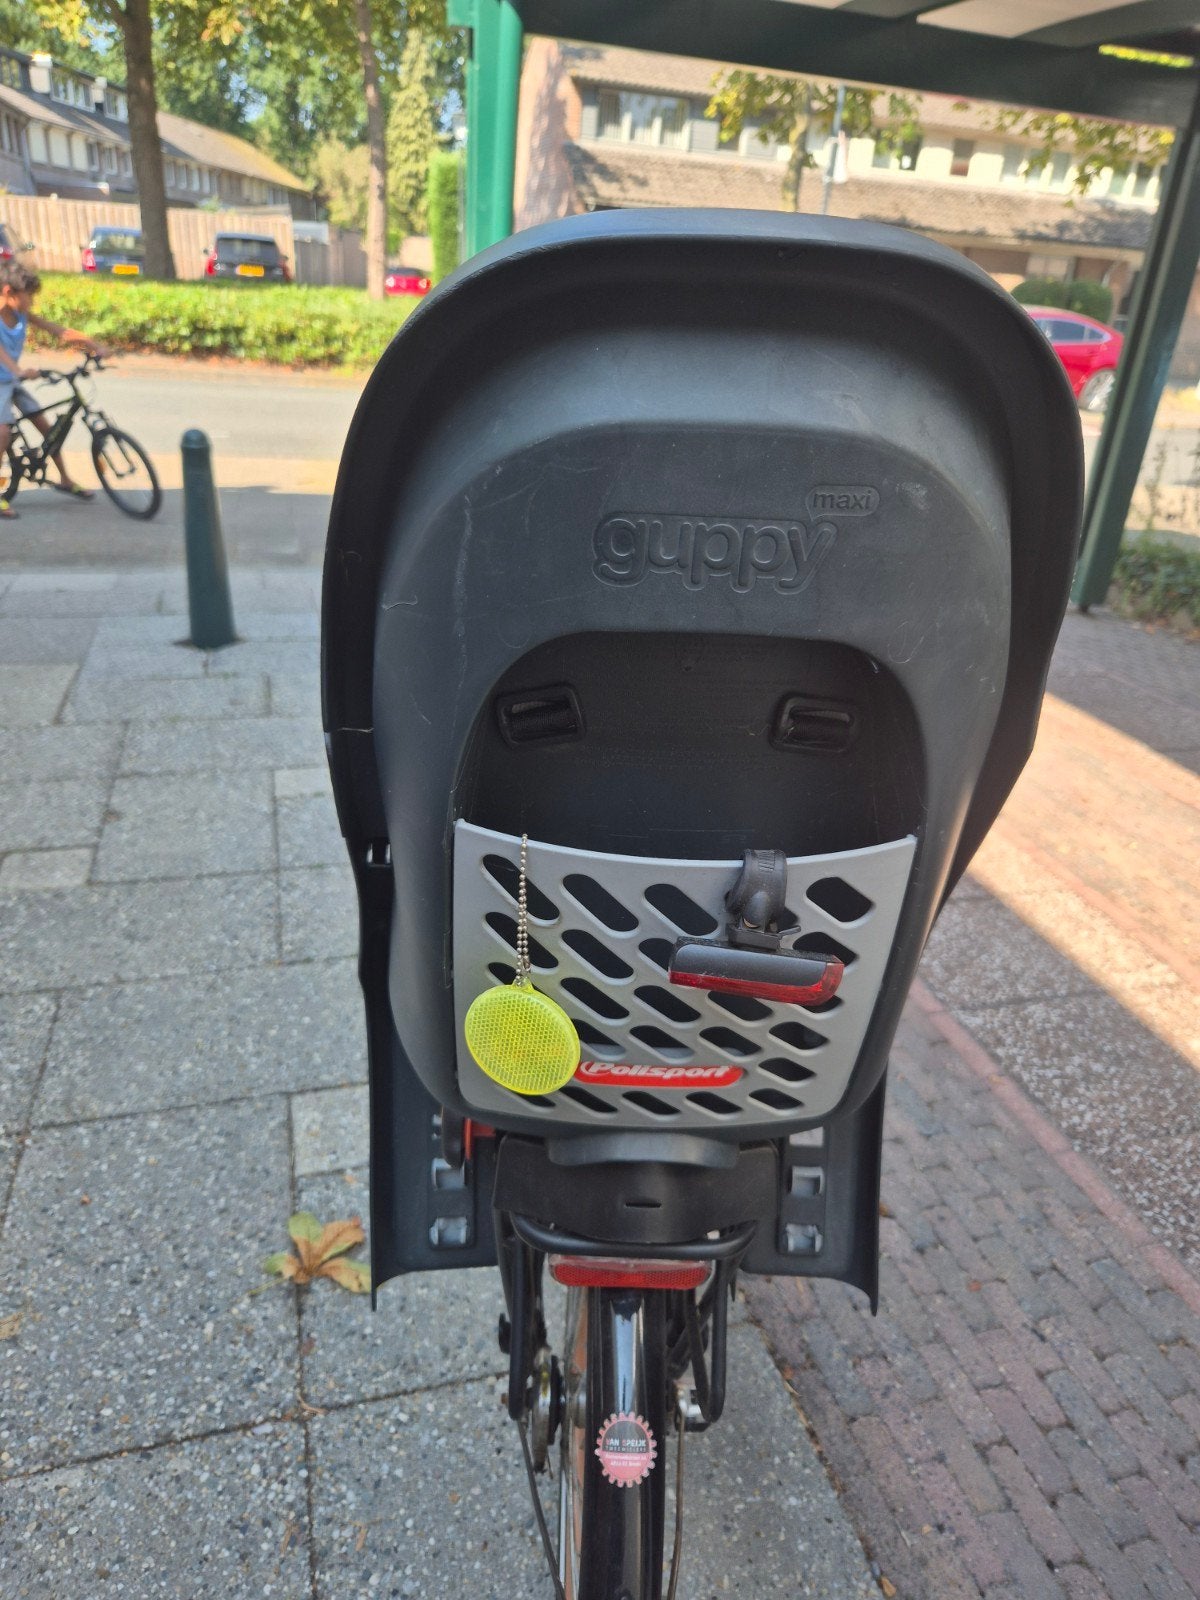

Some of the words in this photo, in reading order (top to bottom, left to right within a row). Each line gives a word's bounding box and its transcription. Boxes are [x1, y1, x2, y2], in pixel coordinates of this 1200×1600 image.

[812, 489, 873, 510] maxi
[596, 517, 836, 592] guppy
[580, 1060, 730, 1079] Polisport
